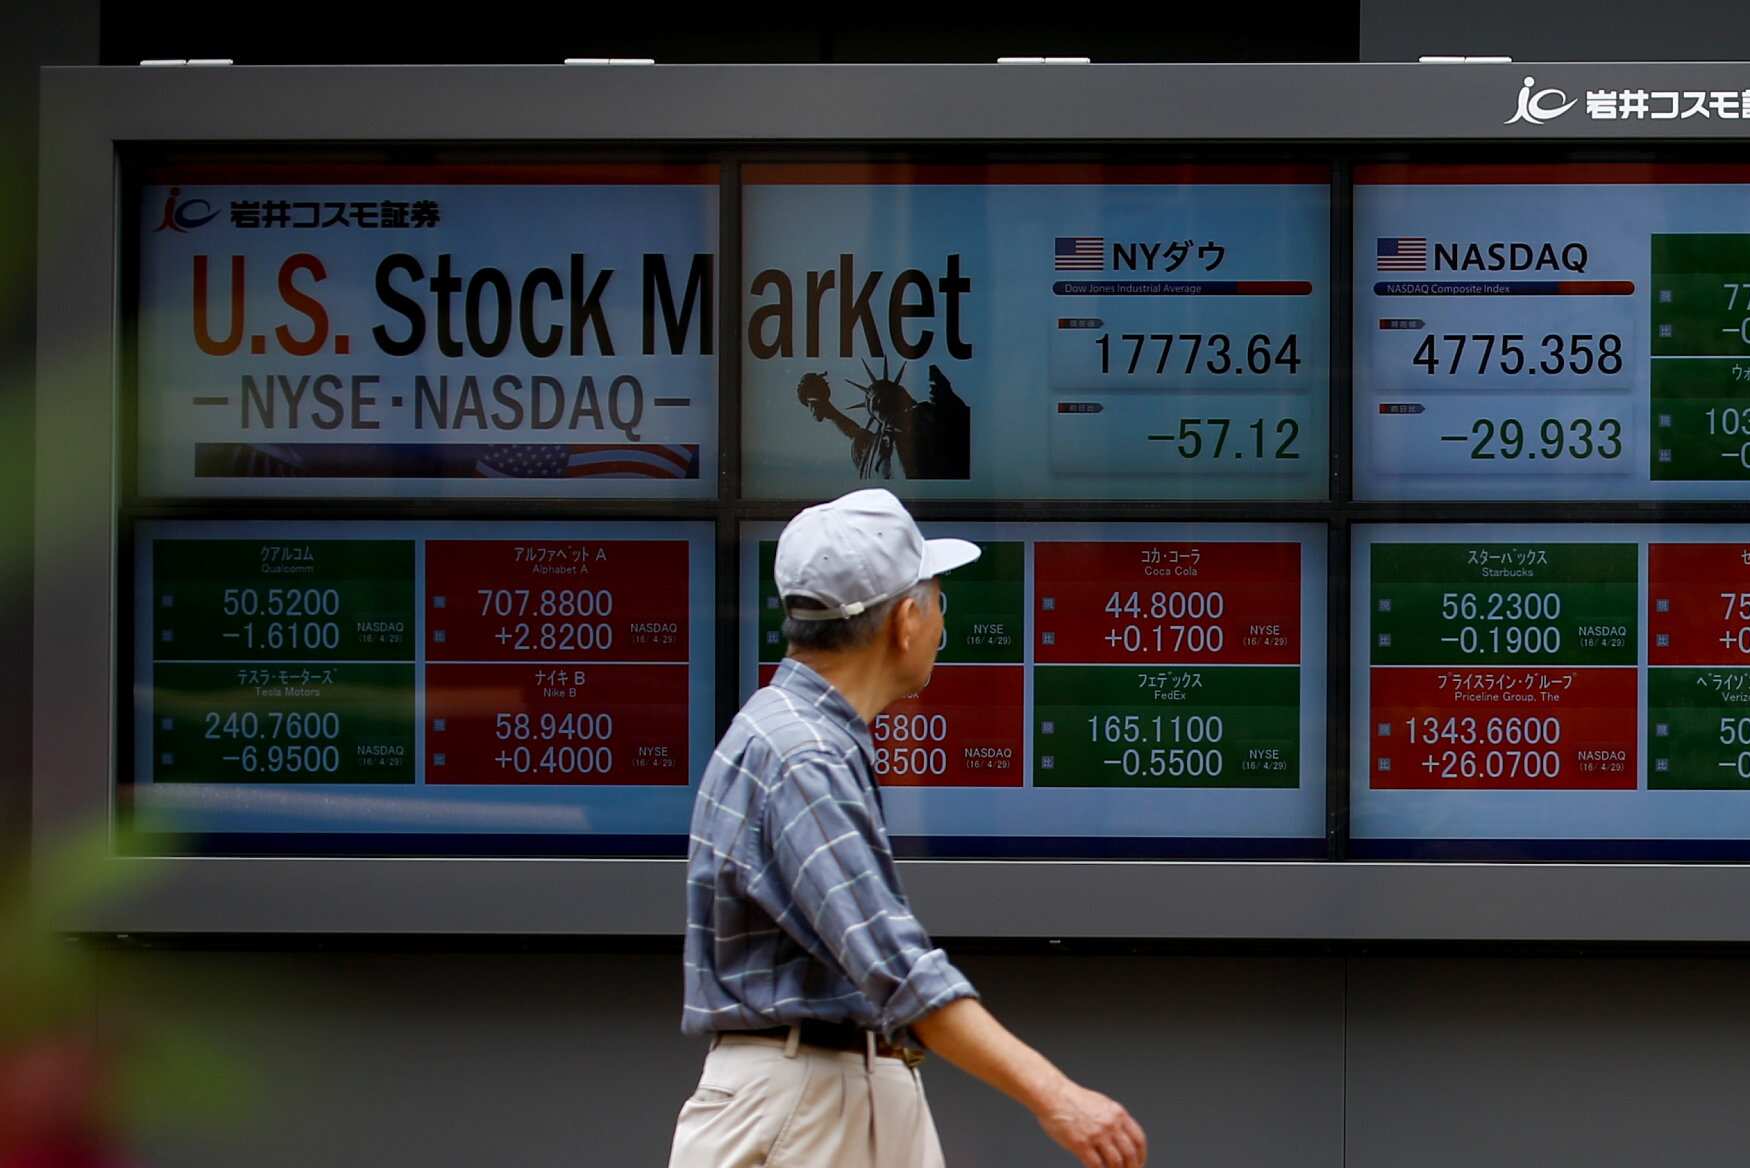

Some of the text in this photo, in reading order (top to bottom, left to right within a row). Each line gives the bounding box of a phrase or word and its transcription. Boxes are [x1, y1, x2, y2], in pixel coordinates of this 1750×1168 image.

[230, 200, 441, 229] 岩井コスモ証券
[1113, 240, 1226, 272] NYダウ
[1434, 243, 1588, 273] NASDAQ
[1386, 283, 1511, 296] NASDAQ Composite Index
[193, 253, 350, 357] U.S.
[371, 252, 616, 358] Stock
[1095, 333, 1302, 374] 17773.64
[1412, 334, 1623, 375] 4775.358
[1147, 417, 1301, 460] -57.12
[1441, 417, 1623, 461] -29.933
[1144, 565, 1200, 577] Coca Cola
[1481, 566, 1534, 577] Starbucks
[223, 588, 340, 617] 50.5200
[477, 589, 613, 617] 707.8800
[1104, 591, 1224, 619] 44.8000
[1442, 592, 1561, 621] 56.2300
[222, 621, 340, 649] -1.6100
[495, 622, 613, 651] +2.8200
[973, 623, 1005, 635] NYSE
[1104, 624, 1224, 652] +0.1700
[1249, 624, 1281, 636] NYSE
[1440, 626, 1561, 654] -0.1900
[1578, 625, 1627, 637] NASDAQ
[1153, 690, 1188, 701] FedEx
[205, 711, 339, 739] 240.7600
[495, 712, 613, 740] 58.9400
[874, 713, 948, 742] 5800
[1088, 715, 1223, 743] 165.1100
[1406, 716, 1561, 745] 1343.6600
[222, 745, 340, 773] -6.9500
[494, 746, 613, 774] +0.4000
[873, 747, 947, 775] 8500
[963, 747, 1013, 760] NASDAQ
[1103, 748, 1223, 777] -0.5500
[1249, 749, 1280, 760] NYSE
[1421, 750, 1560, 778] +26.0700
[1578, 750, 1626, 761] NASDAQ
